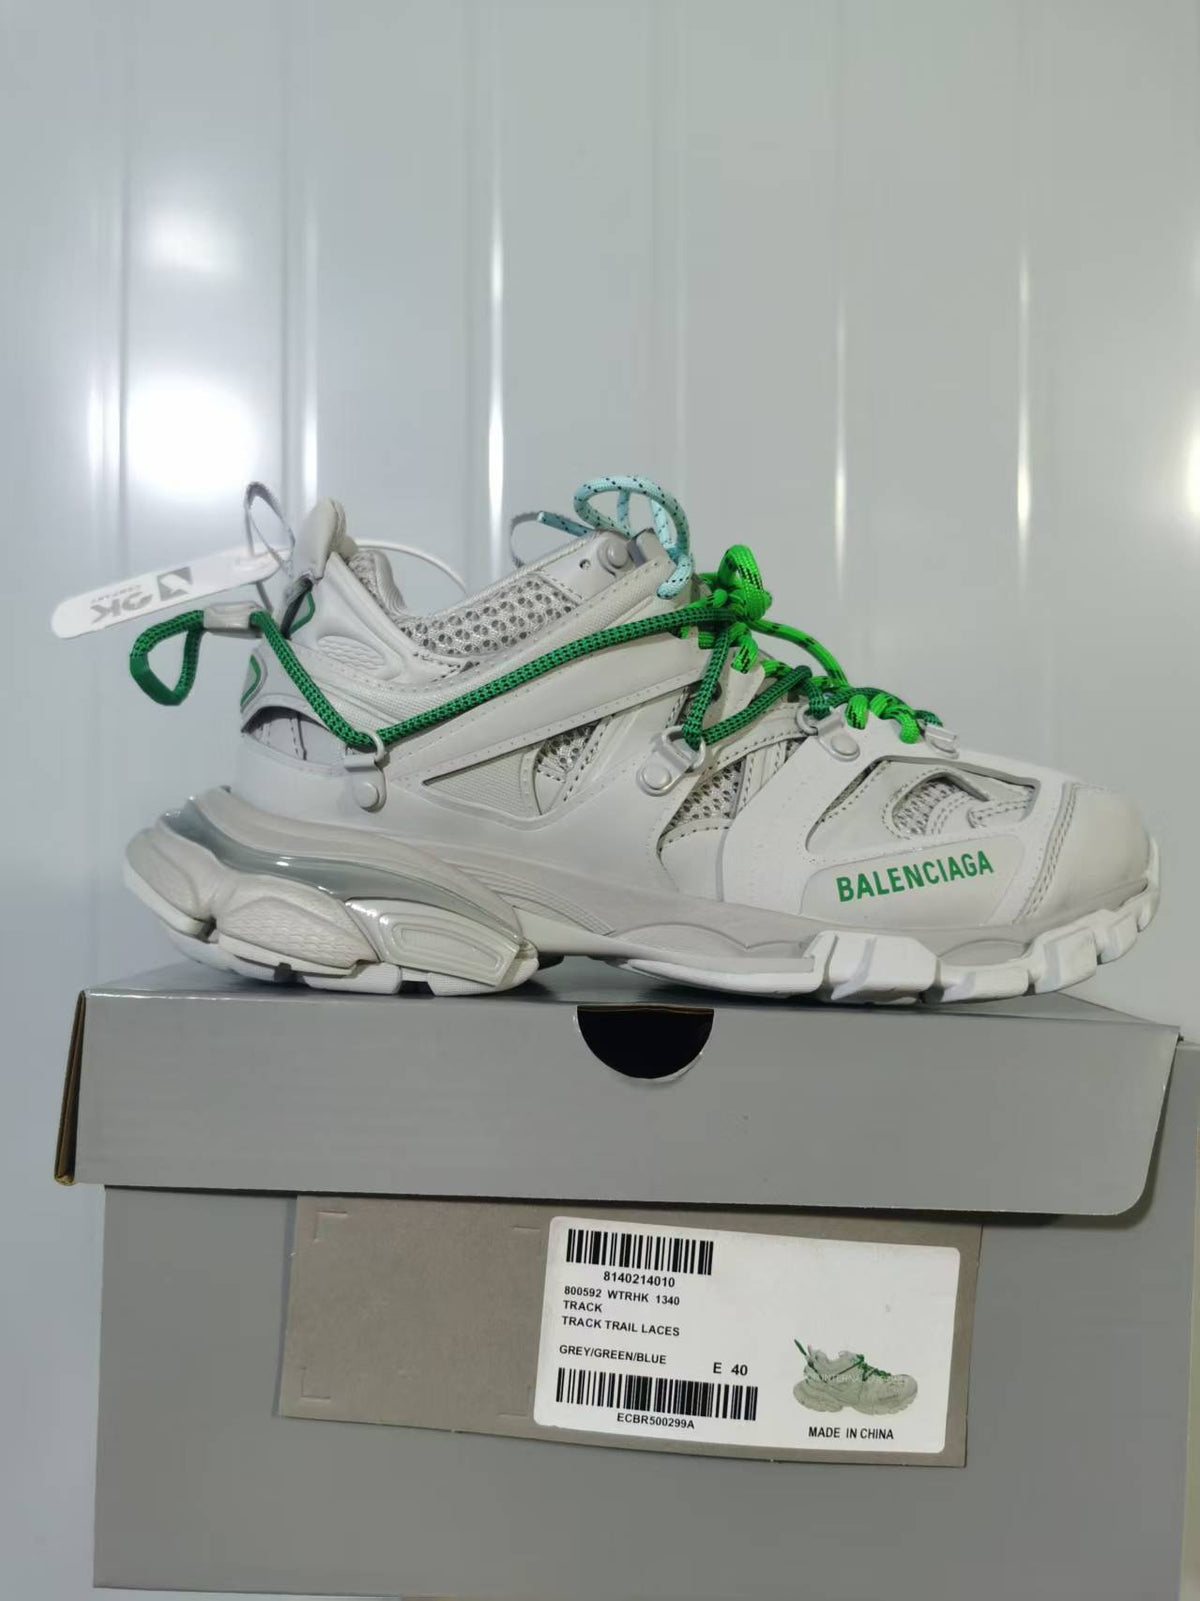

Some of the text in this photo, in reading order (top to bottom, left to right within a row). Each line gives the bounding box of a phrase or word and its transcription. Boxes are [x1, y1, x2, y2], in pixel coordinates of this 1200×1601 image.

[836, 850, 994, 902] BALENCIAGA
[603, 1271, 676, 1288] 8140214010
[564, 1286, 680, 1306] 800592 WTRHK 1340
[563, 1300, 603, 1313] TRACK
[561, 1316, 680, 1336] TRACK TRAIL LACES
[559, 1344, 667, 1365] GREY/GREEN/BLUE
[712, 1361, 748, 1376] E 40
[616, 1412, 695, 1429] ECBR500299A
[808, 1426, 894, 1439] MADE IN CHINA
